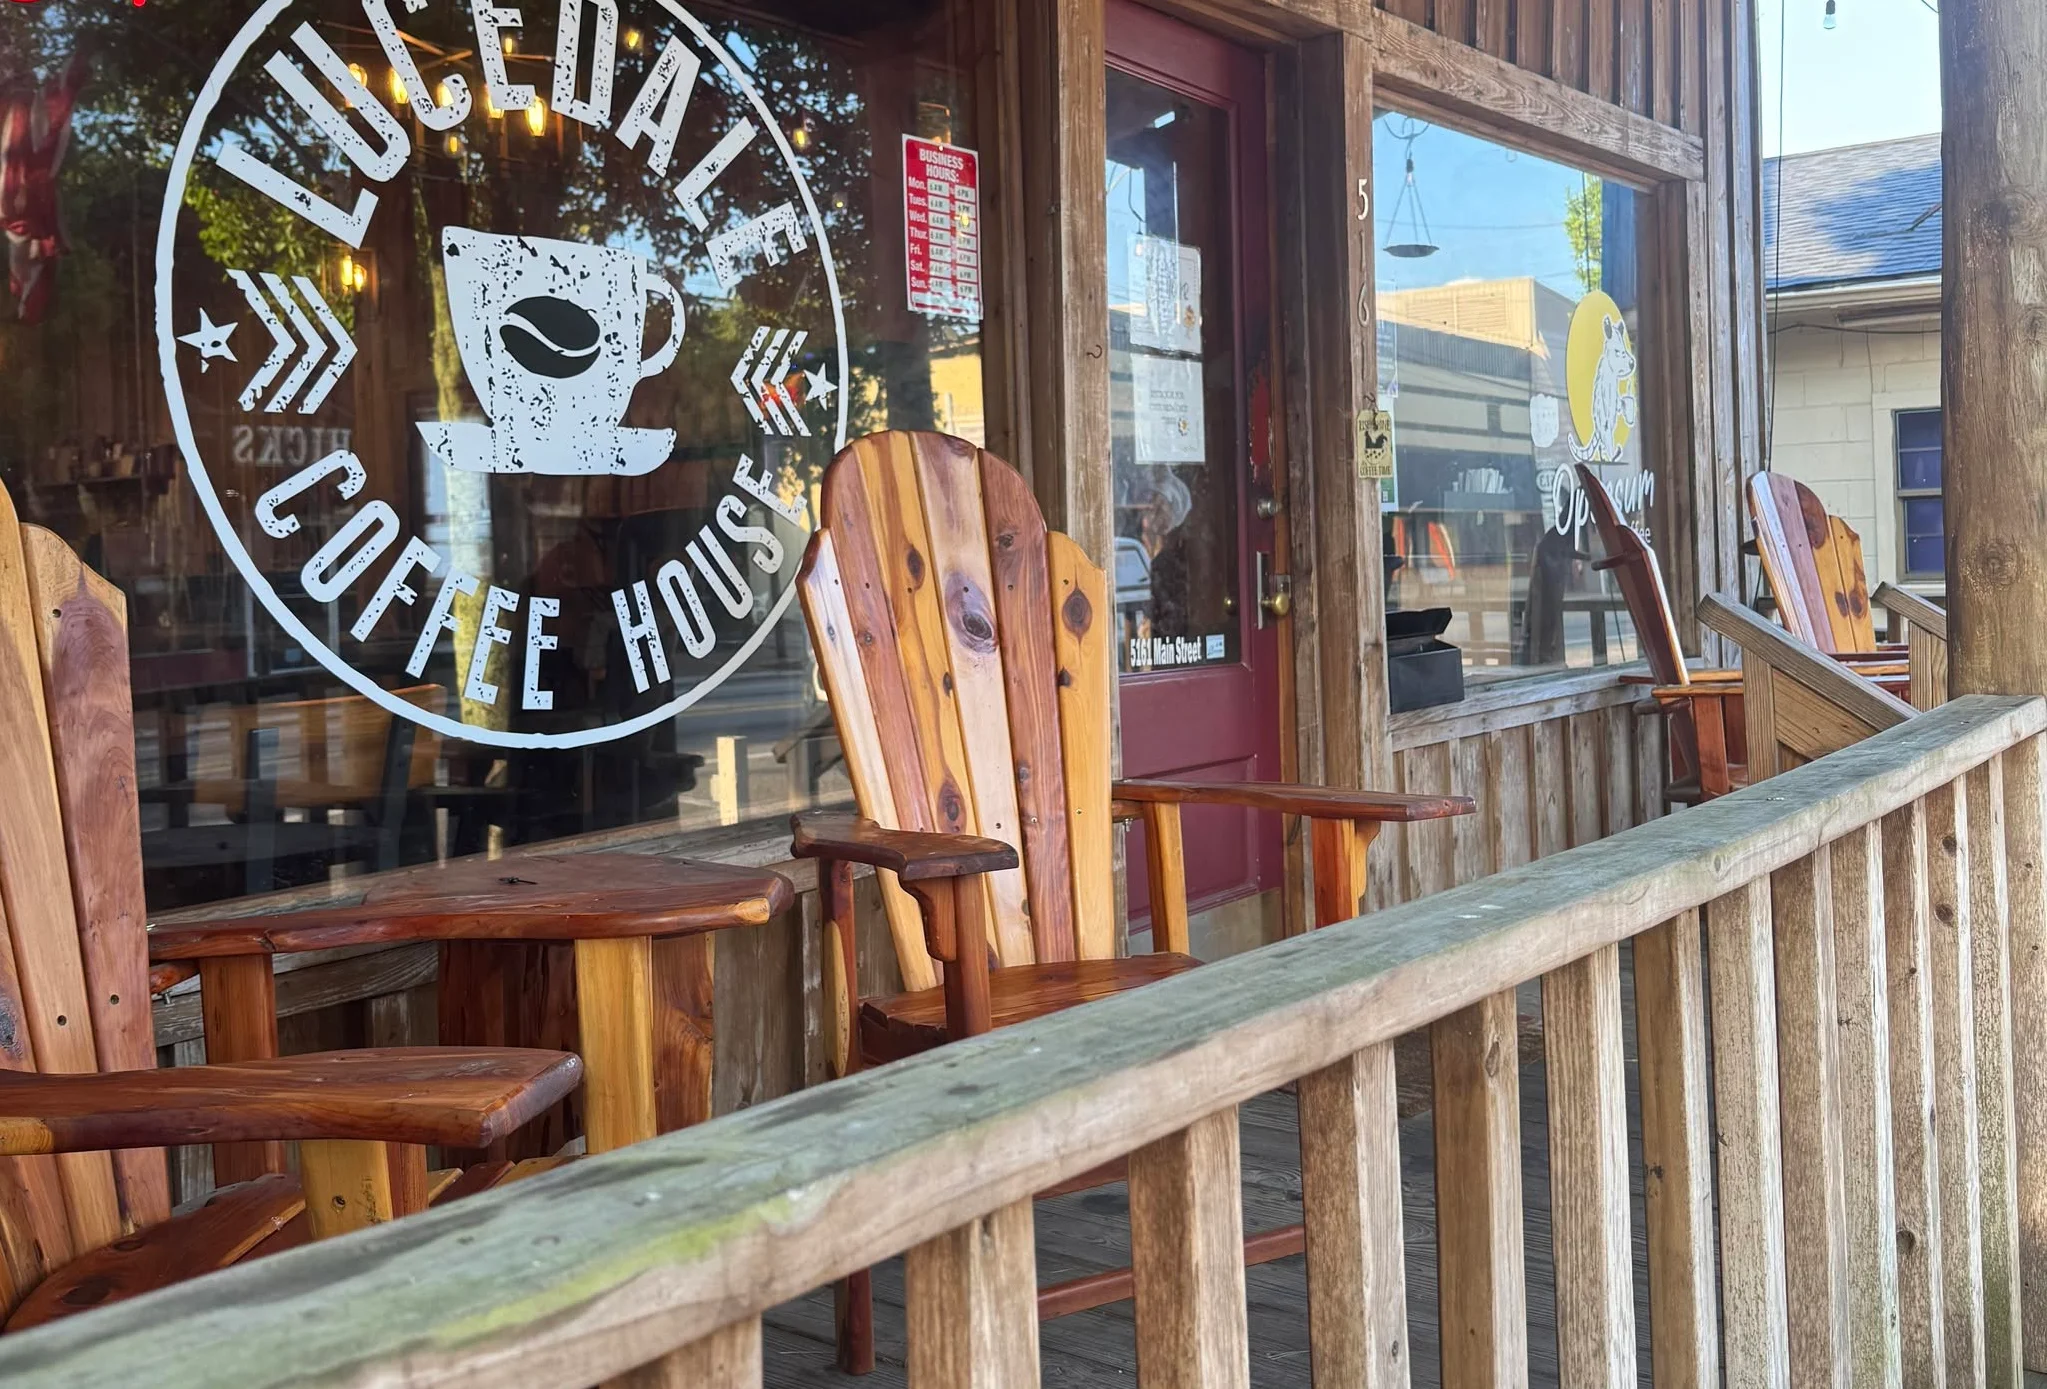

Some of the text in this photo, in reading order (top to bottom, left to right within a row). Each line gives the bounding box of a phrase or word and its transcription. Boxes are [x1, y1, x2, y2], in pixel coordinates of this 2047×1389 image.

[216, 0, 807, 289] LUCEDALE
[918, 148, 964, 171] BUSINESS
[925, 163, 960, 183] HOURS:
[908, 176, 927, 190] Mon.
[908, 193, 928, 207] Tues.
[908, 210, 928, 223] Wed.
[910, 243, 922, 255] Fri.
[910, 260, 925, 272] Sat.
[911, 276, 927, 289] Sun.
[254, 449, 561, 711] COFFEE
[611, 453, 808, 694] HOUSE
[1130, 638, 1153, 667] 5161
[1153, 636, 1175, 665] Main
[1175, 635, 1202, 665] Street
